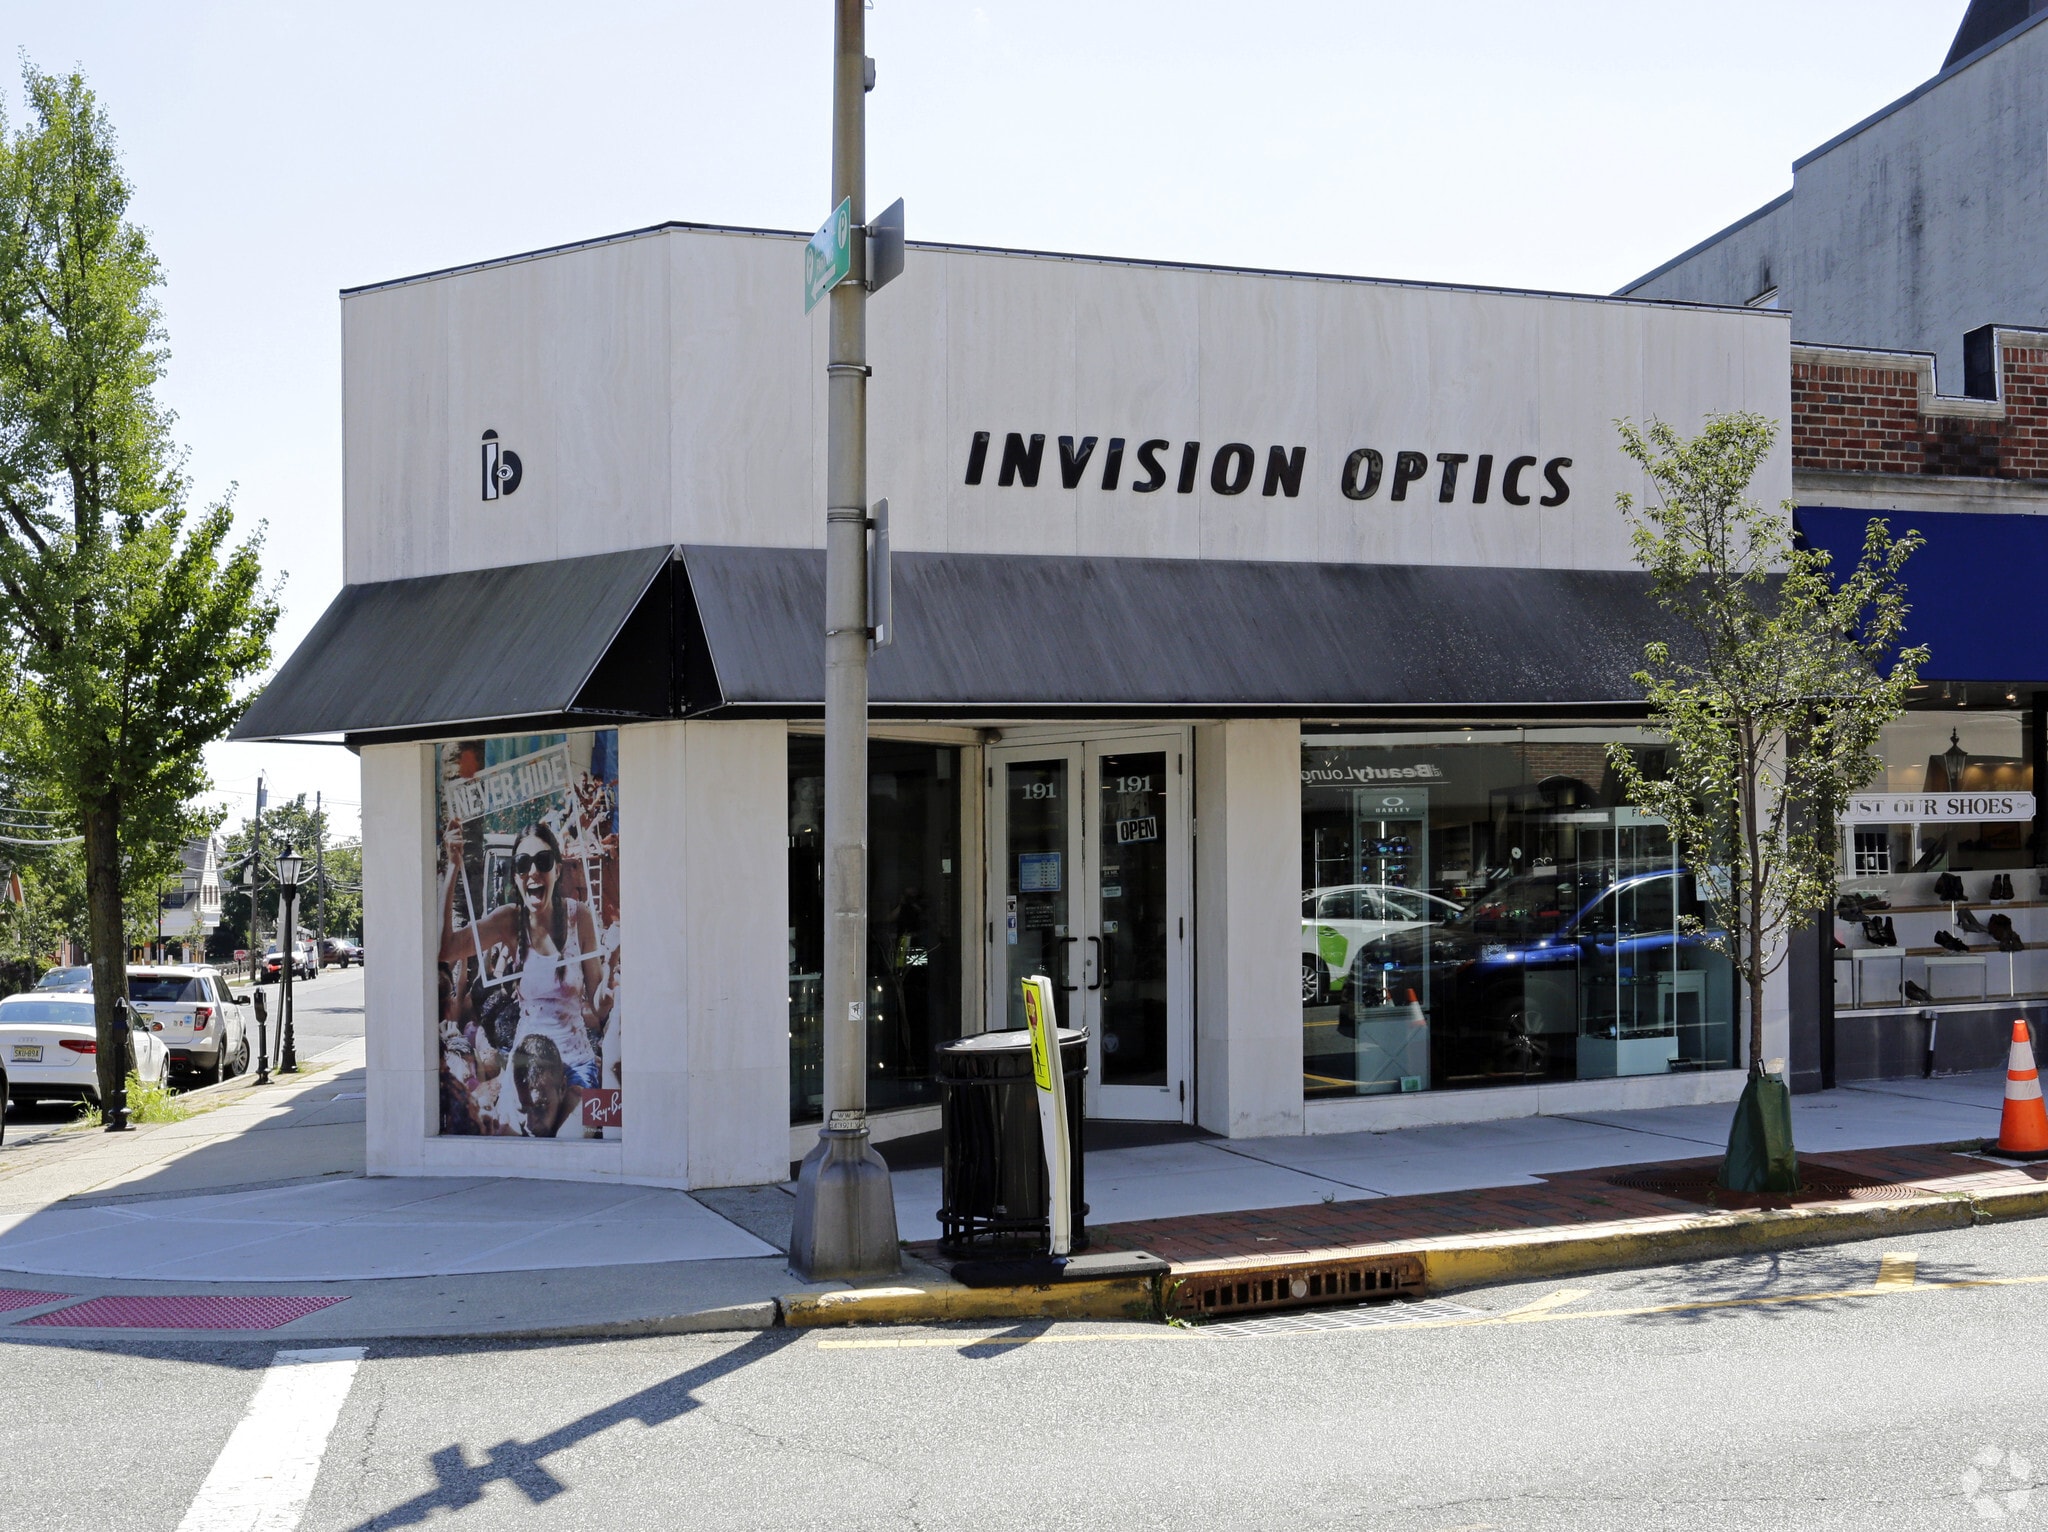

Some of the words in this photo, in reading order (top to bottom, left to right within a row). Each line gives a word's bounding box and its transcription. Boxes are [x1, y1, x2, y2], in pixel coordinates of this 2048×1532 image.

[965, 431, 1307, 498] INVISION
[1341, 448, 1573, 507] OPTICS
[452, 772, 517, 819] NEVER
[519, 754, 566, 799] HIDE
[1022, 782, 1056, 800] 191
[1116, 775, 1153, 793] 191
[1893, 799, 1938, 816] OUR
[1946, 797, 2013, 815] SHOES
[1120, 818, 1155, 841] OPEN
